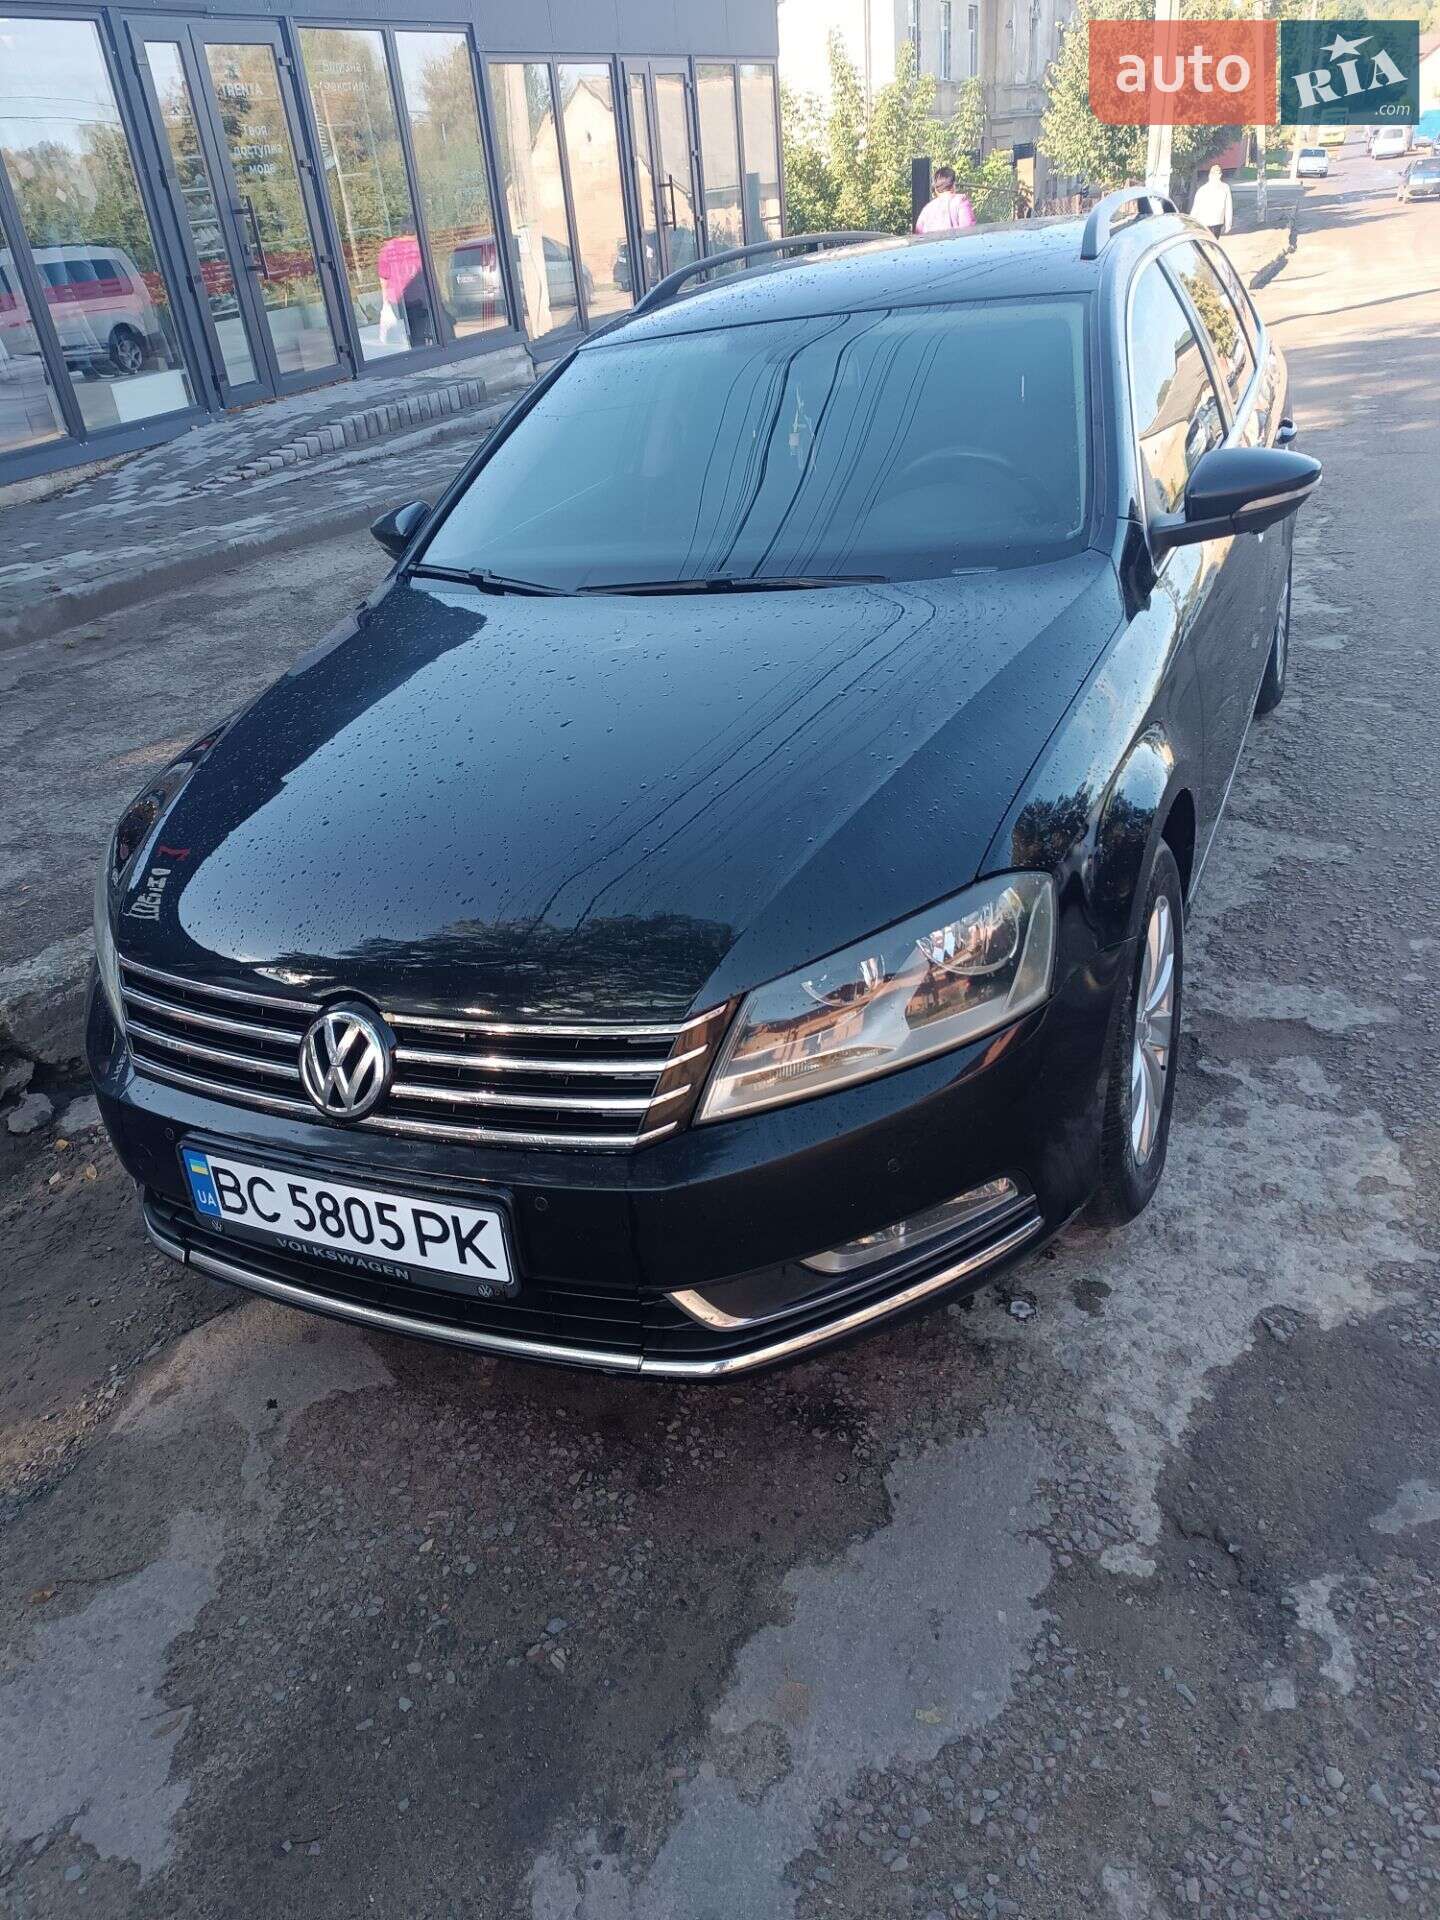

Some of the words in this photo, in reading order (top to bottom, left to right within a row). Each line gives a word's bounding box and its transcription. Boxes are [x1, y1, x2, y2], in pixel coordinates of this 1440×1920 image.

[199, 1190, 217, 1208] UA
[211, 1165, 281, 1223] BC
[287, 1183, 406, 1251] 5805
[411, 1208, 497, 1270] PK
[276, 1237, 410, 1281] VOLKSWAGEN
